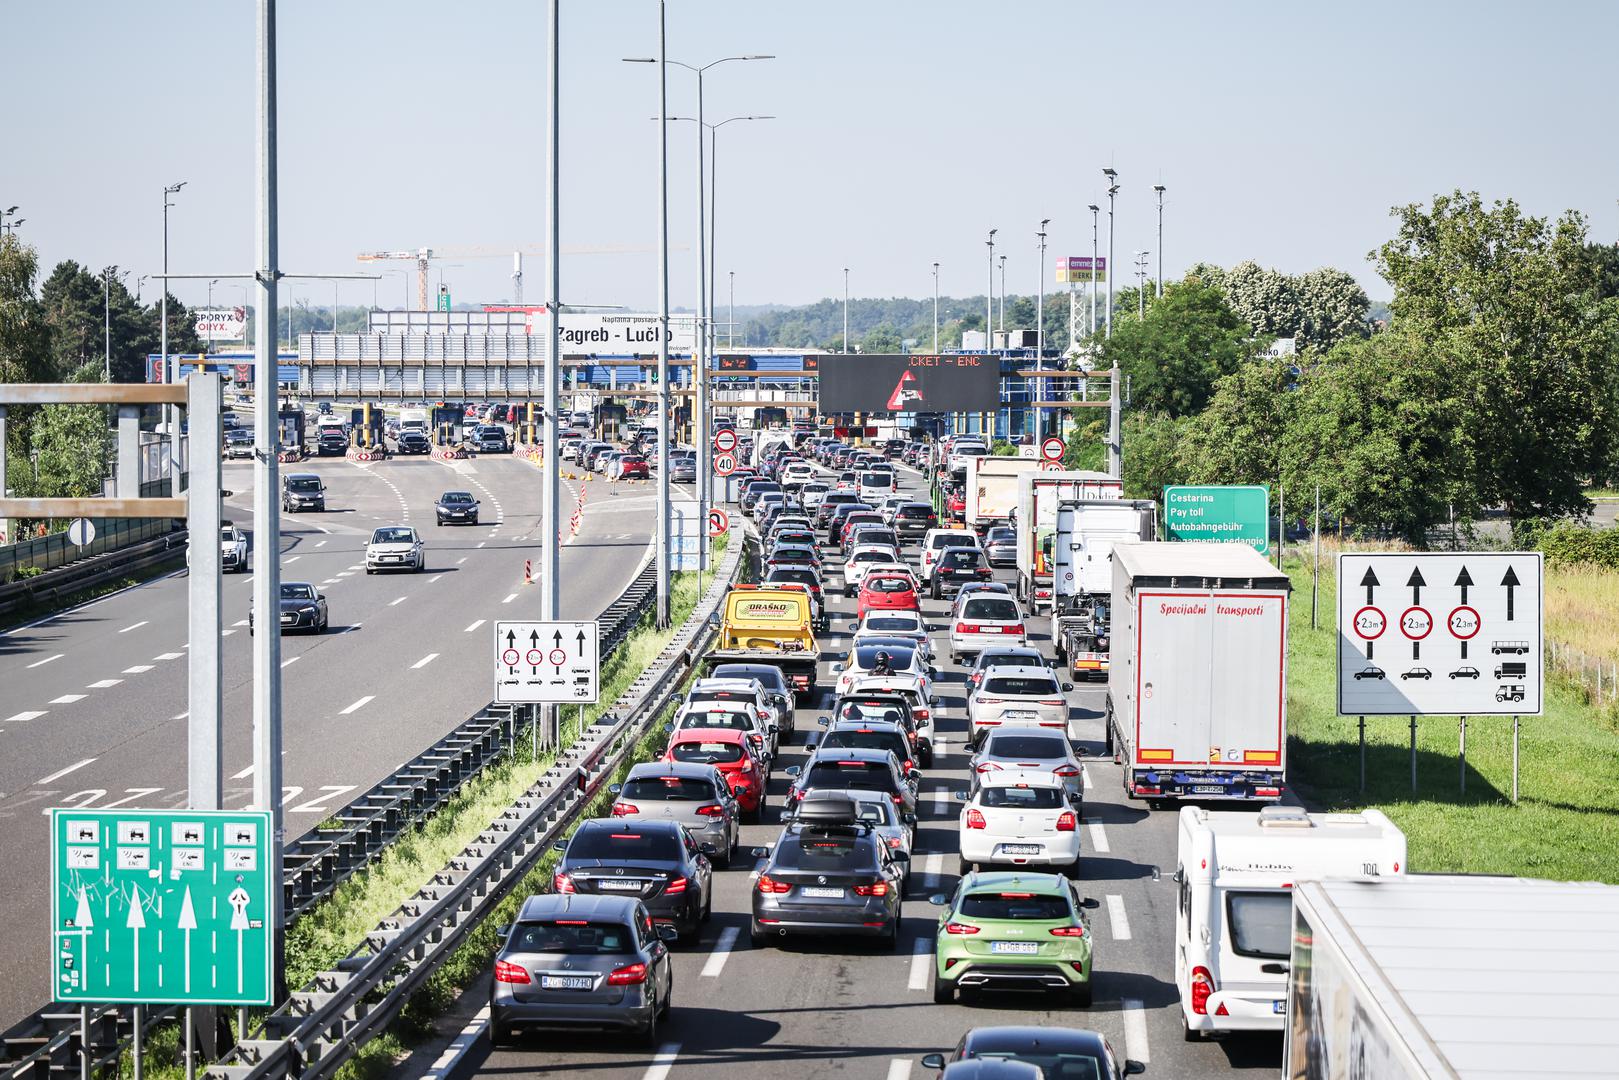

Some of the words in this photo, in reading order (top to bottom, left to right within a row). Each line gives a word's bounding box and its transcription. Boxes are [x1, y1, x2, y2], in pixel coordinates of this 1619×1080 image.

[558, 327, 609, 345] Zagreb
[957, 356, 981, 366] ENC
[719, 458, 732, 470] 40
[1170, 493, 1214, 503] Cestarina
[1170, 508, 1187, 518] Pay
[1189, 507, 1204, 517] toll
[1170, 522, 1244, 533] Autobahngebühr
[1160, 603, 1207, 616] Specijalni
[1216, 604, 1264, 617] transporti
